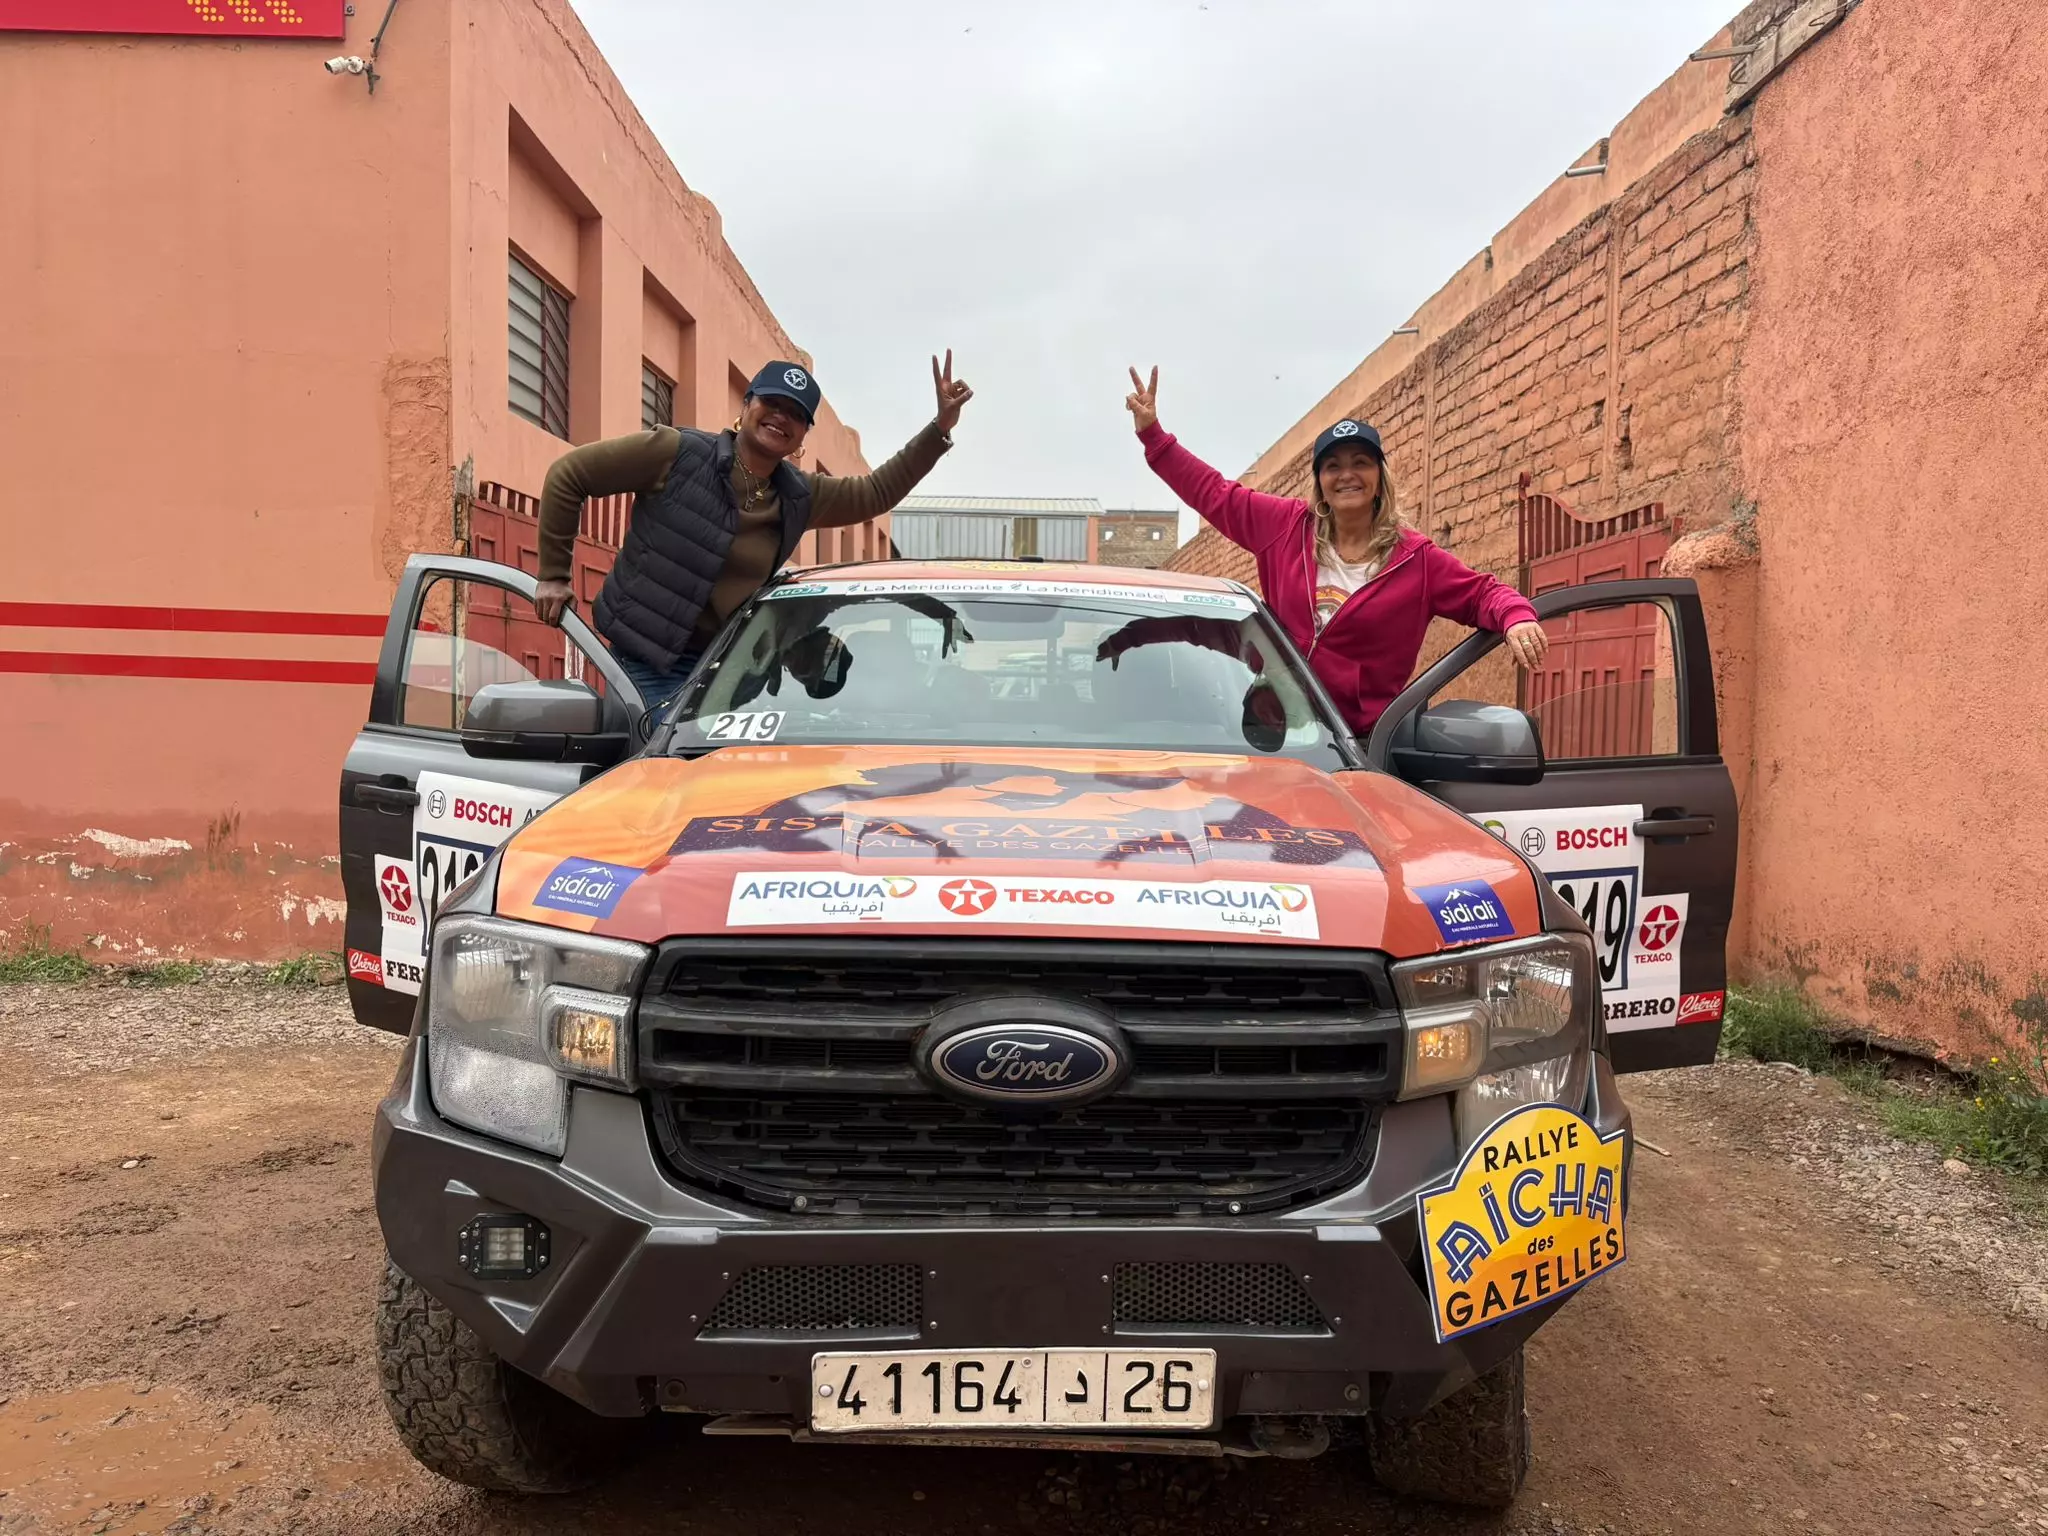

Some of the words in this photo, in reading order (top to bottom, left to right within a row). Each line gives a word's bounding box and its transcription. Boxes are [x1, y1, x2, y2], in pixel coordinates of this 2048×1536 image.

[709, 712, 780, 739] 219
[453, 797, 512, 828] BOSCH
[846, 836, 964, 848] RALLYE
[975, 840, 1036, 850] DES
[1050, 841, 1213, 855] GAZELLES
[941, 822, 1345, 847] GAZELLES
[1556, 827, 1628, 851] BOSCH
[550, 875, 590, 895] sidi
[586, 881, 616, 900] ali
[739, 880, 886, 900] AFRIQUIA
[1004, 889, 1114, 905] TEXACO
[1137, 888, 1281, 910] AFRIQUIA
[386, 911, 416, 925] TEXACO
[1440, 903, 1475, 925] sidi
[1473, 900, 1498, 920] ali
[1635, 953, 1672, 964] TEXACO
[976, 1040, 1074, 1081] Ford
[1483, 1122, 1578, 1173] RALLYE
[1527, 1233, 1554, 1256] des
[1446, 1227, 1619, 1327] GAZELLES
[837, 1360, 1023, 1416] 41164
[1123, 1360, 1194, 1414] 26
